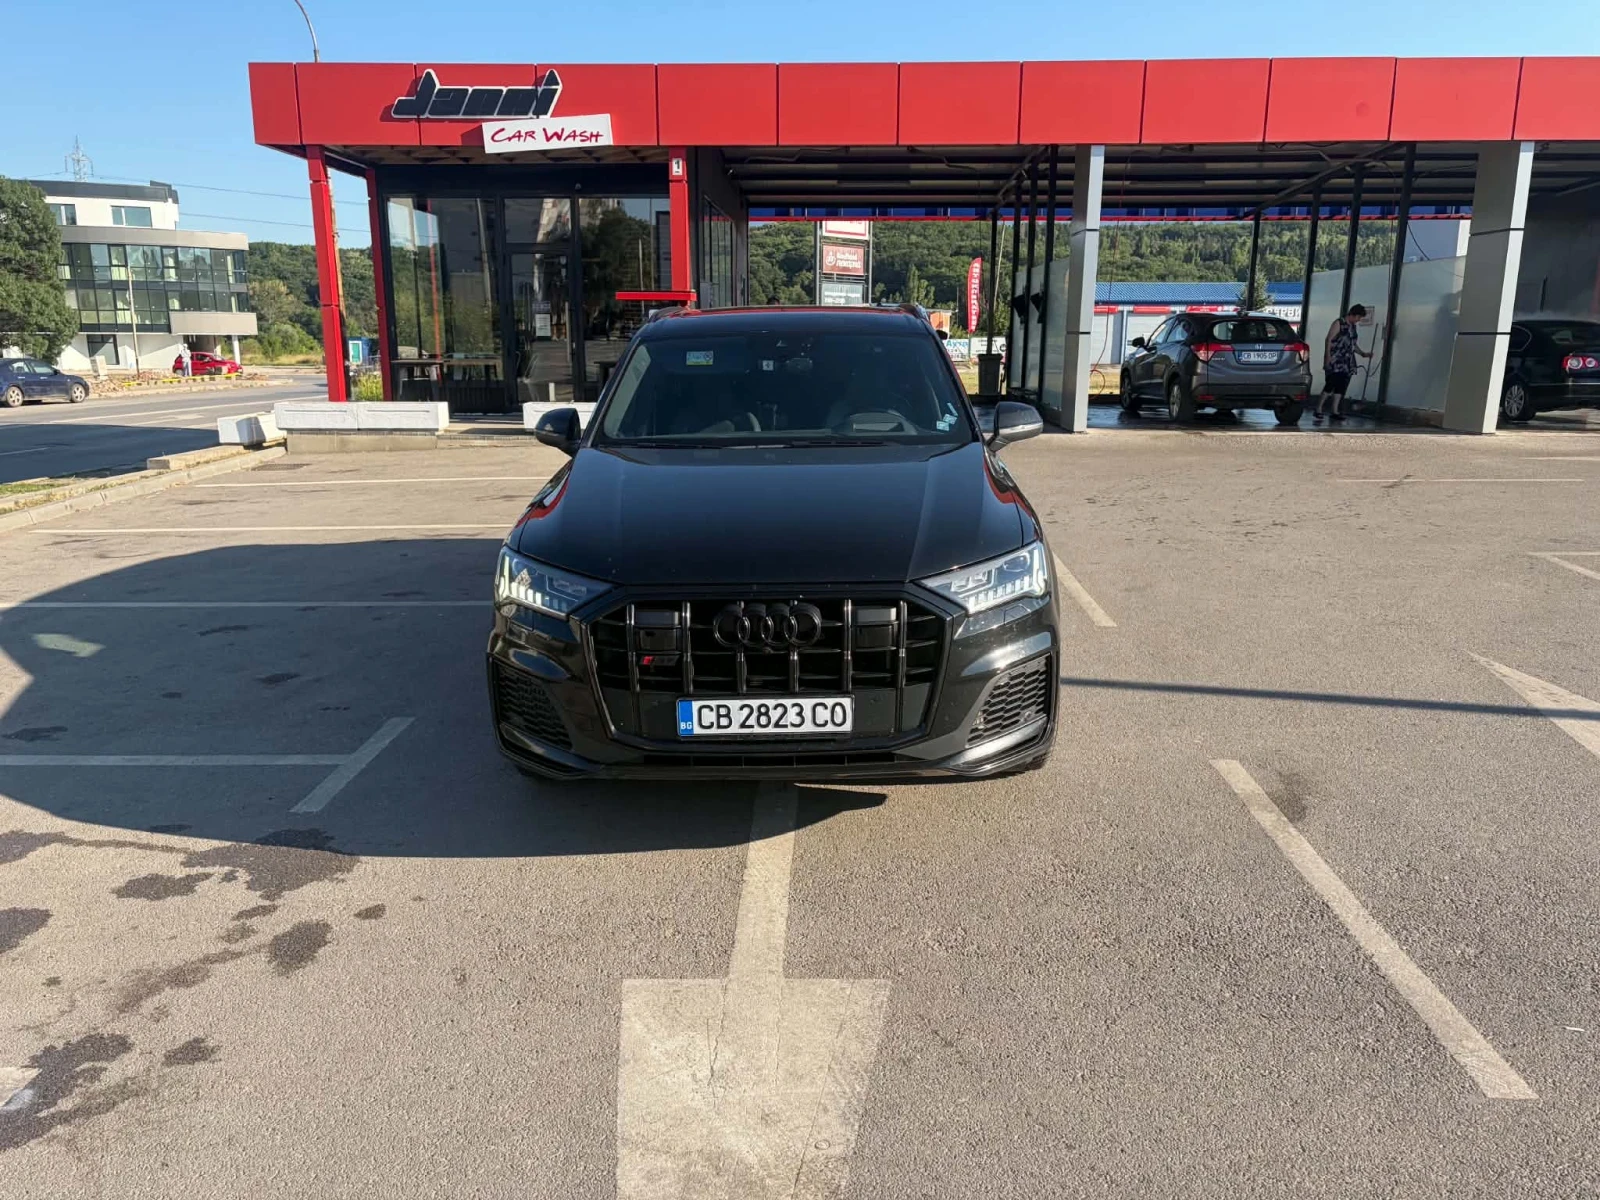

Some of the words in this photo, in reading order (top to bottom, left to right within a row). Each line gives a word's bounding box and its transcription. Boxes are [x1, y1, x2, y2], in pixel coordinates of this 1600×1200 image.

[490, 127, 537, 143] CAR
[542, 127, 604, 143] WASH
[674, 159, 680, 170] 1
[697, 704, 733, 730] CB
[739, 703, 806, 729] 2823
[680, 722, 693, 730] BG
